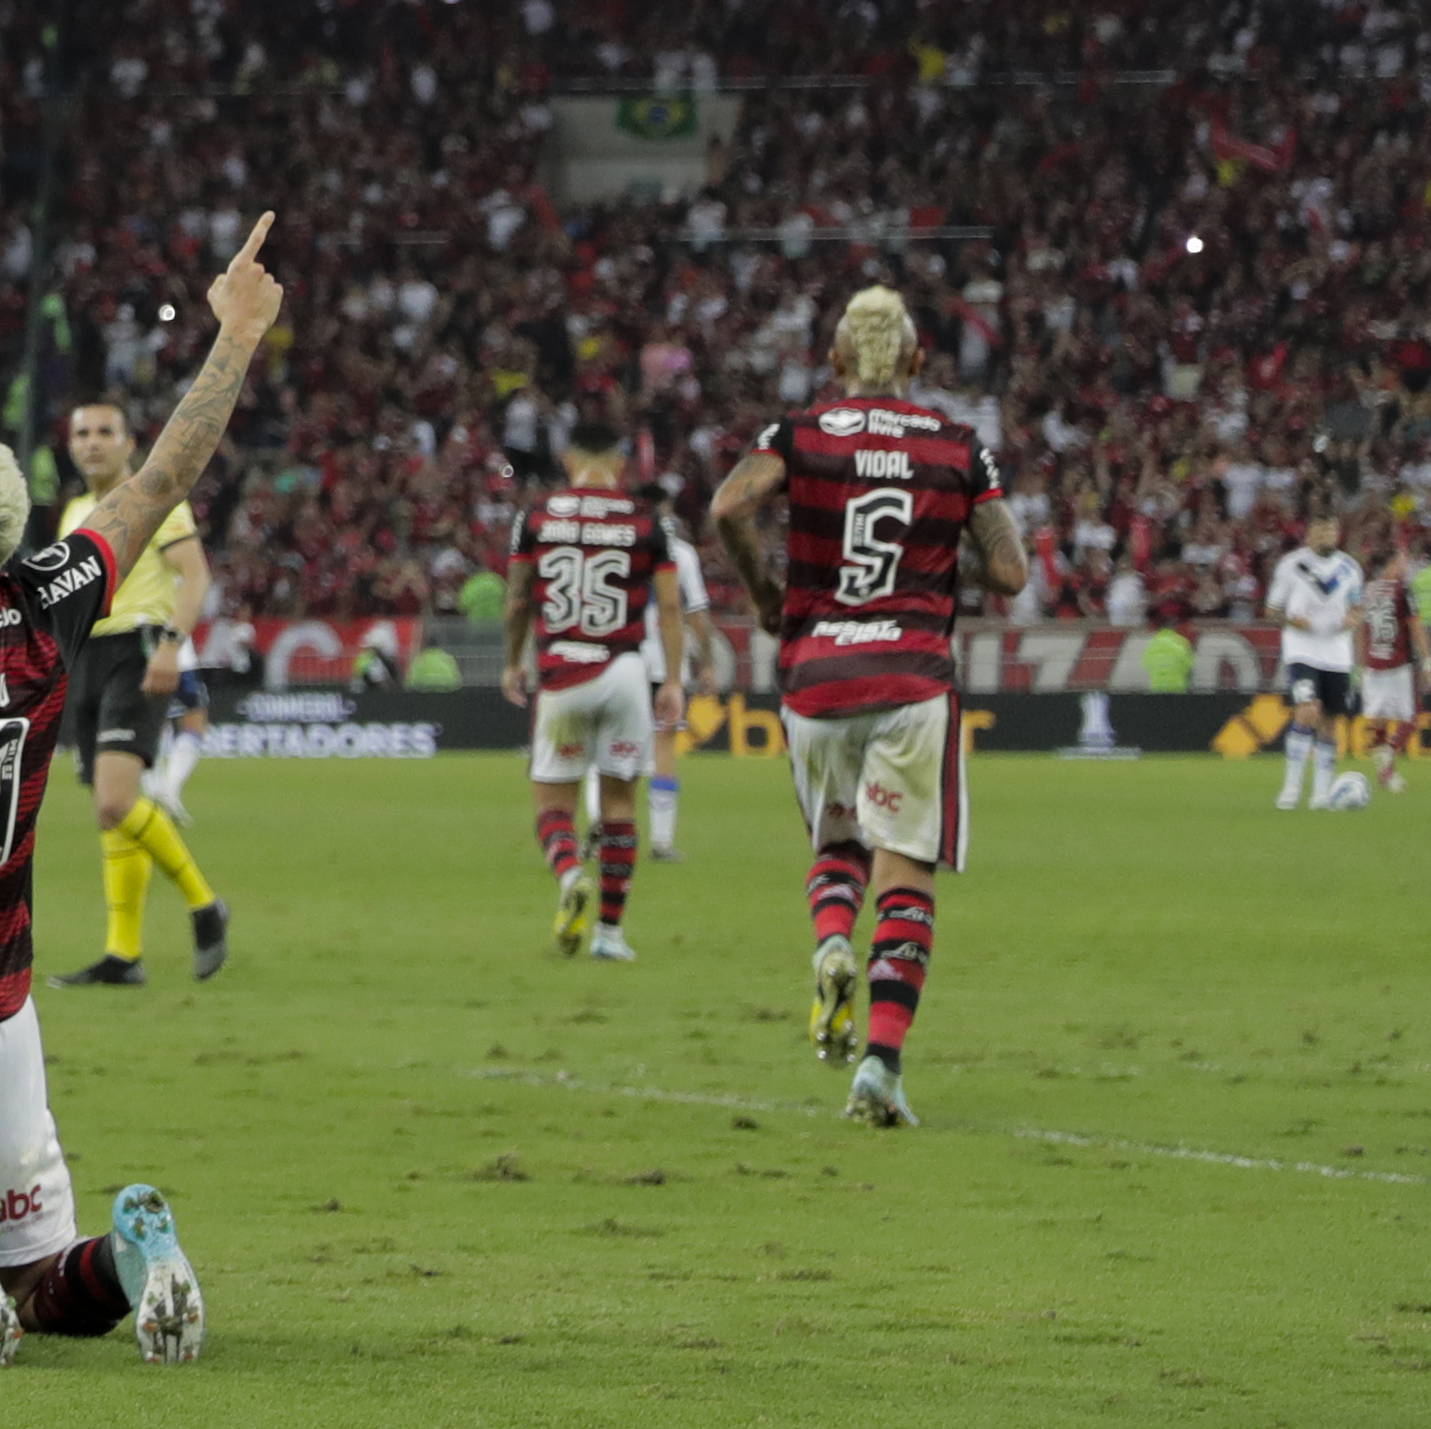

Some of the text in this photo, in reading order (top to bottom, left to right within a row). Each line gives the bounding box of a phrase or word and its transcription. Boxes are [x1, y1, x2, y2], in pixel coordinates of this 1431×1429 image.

[855, 449, 914, 479] VIDAL
[539, 546, 631, 637] 35
[834, 487, 914, 606] 5
